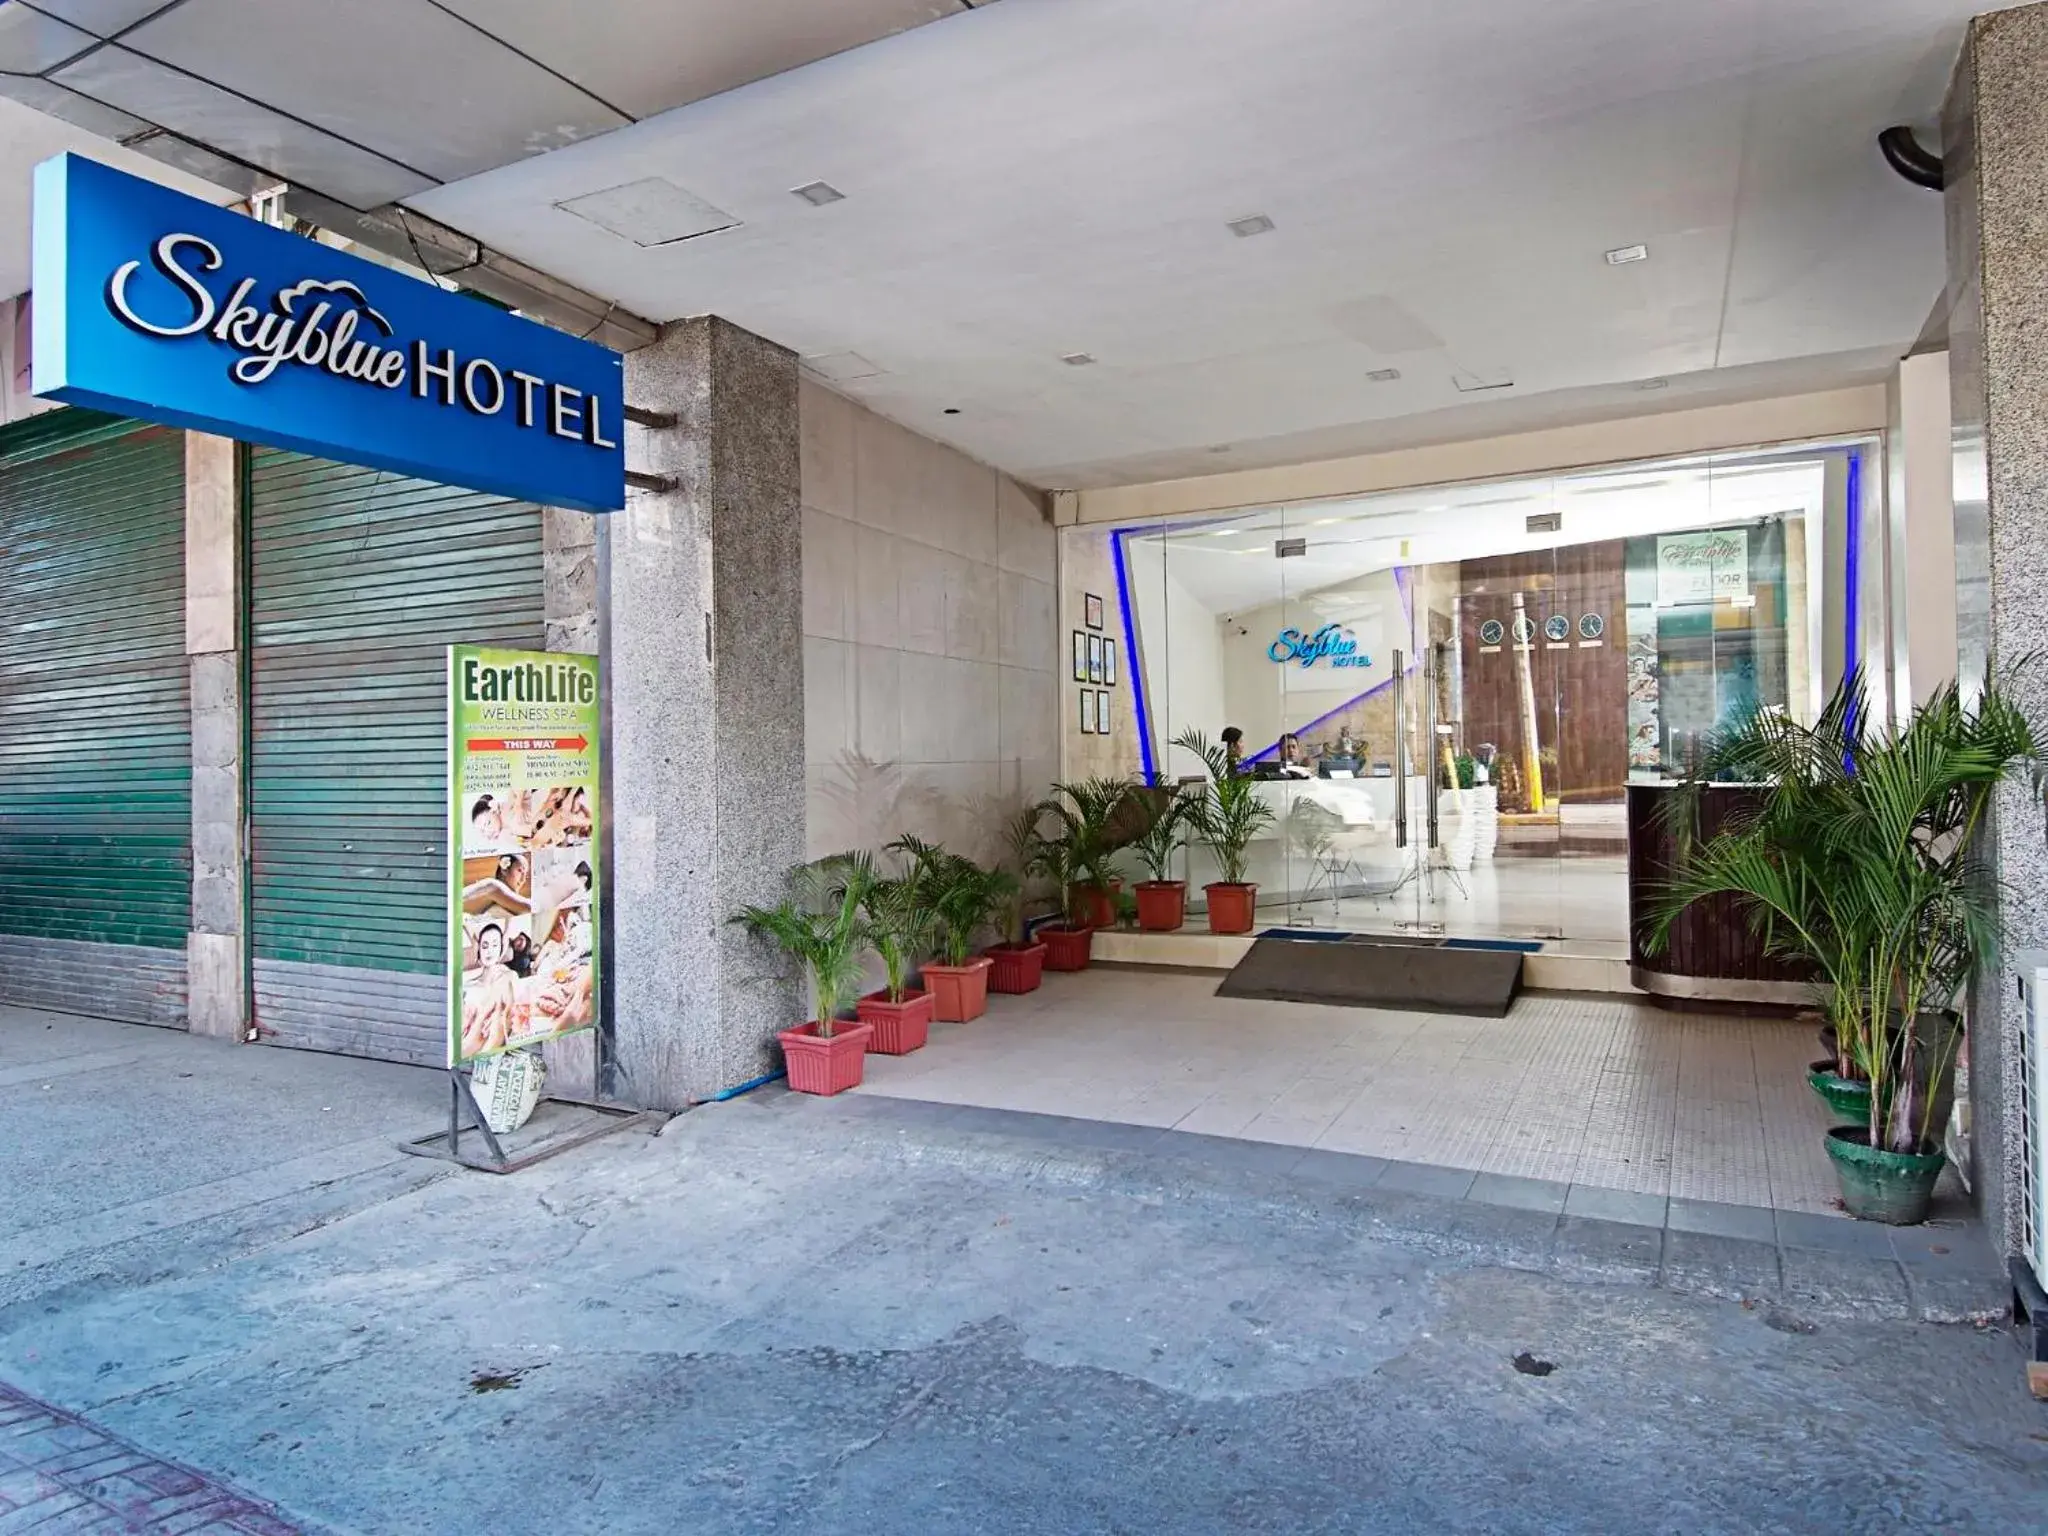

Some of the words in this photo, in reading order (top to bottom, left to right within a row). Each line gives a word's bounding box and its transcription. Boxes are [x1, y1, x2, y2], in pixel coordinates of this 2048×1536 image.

[108, 232, 409, 385] Skyblue
[415, 339, 617, 450] HOTEL
[1267, 625, 1357, 668] Skyblue
[1332, 655, 1372, 668] HOTEL
[464, 660, 594, 704] EarthLife
[482, 707, 549, 721] WELLNESS
[553, 708, 578, 721] SPA
[503, 740, 530, 750] THIS
[532, 740, 557, 750] WAY
